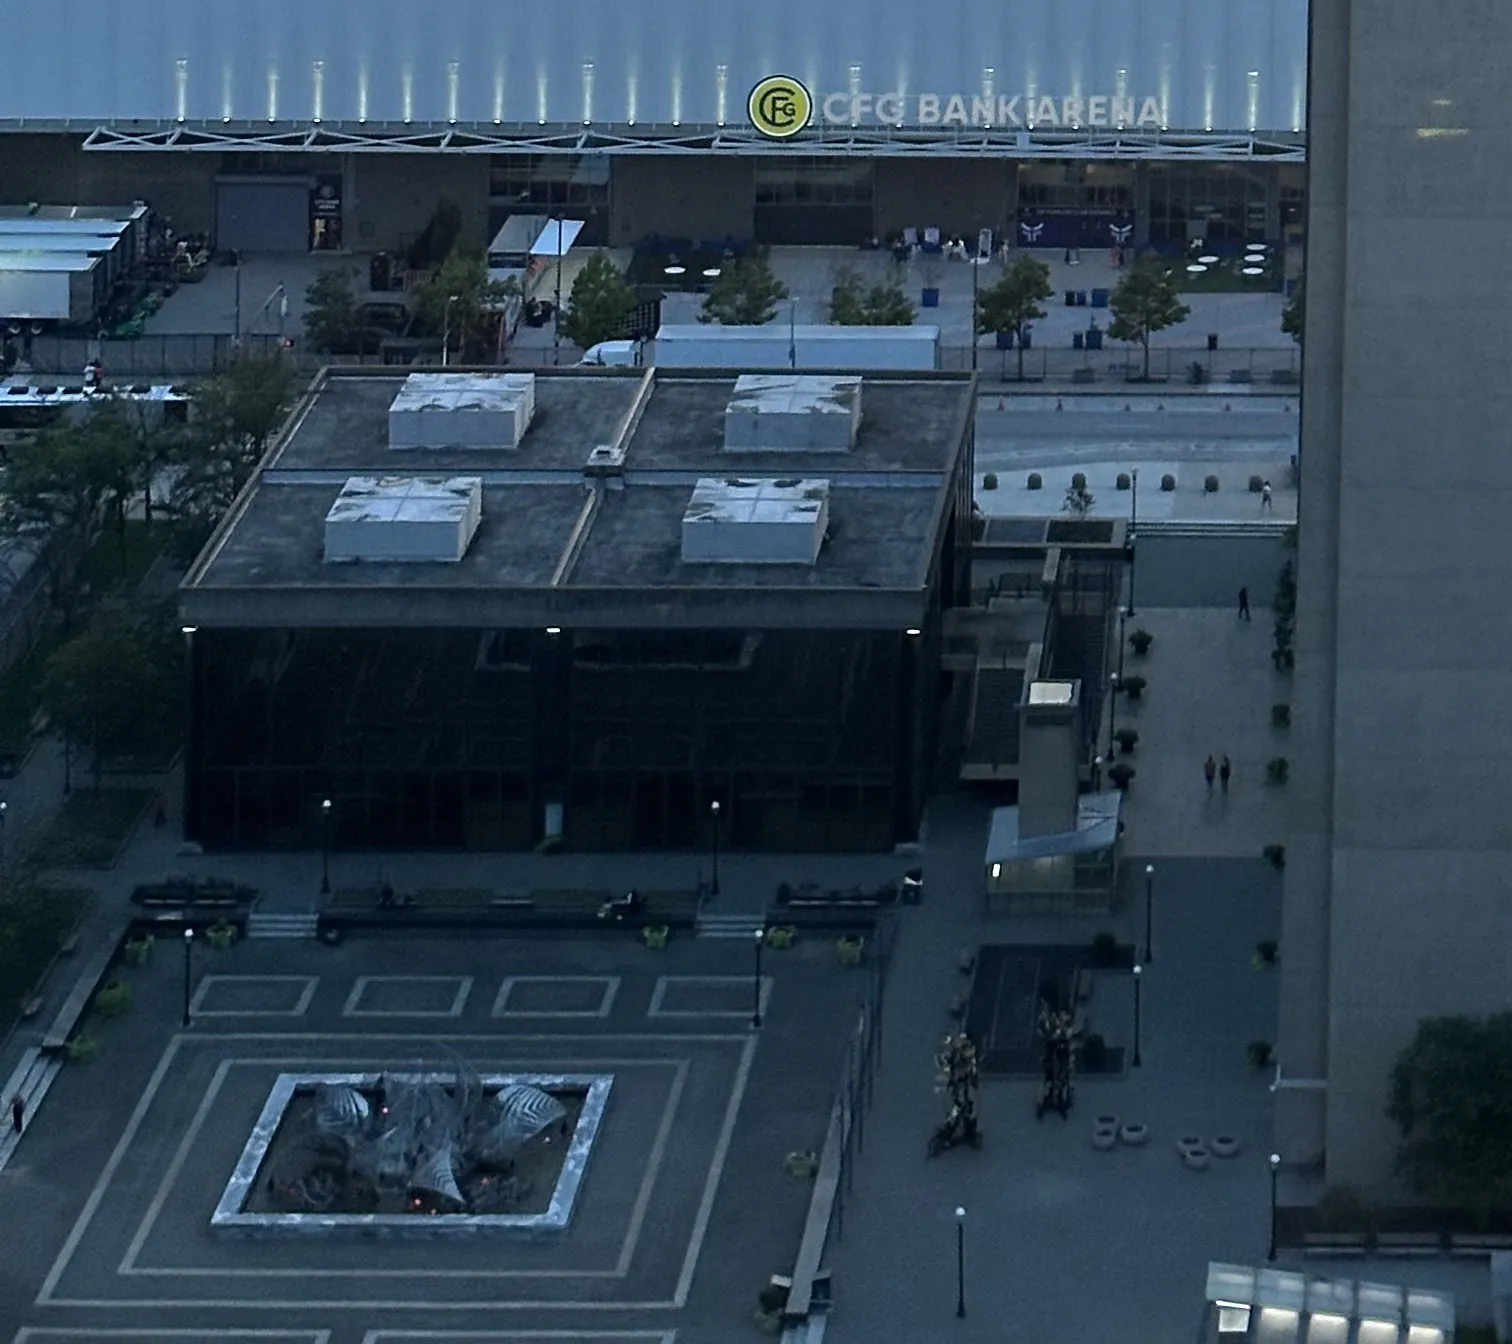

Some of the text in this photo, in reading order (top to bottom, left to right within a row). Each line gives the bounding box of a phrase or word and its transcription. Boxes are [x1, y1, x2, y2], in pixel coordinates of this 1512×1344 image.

[759, 86, 796, 128] CFG
[823, 92, 1164, 126] CFG BANK ARENA
